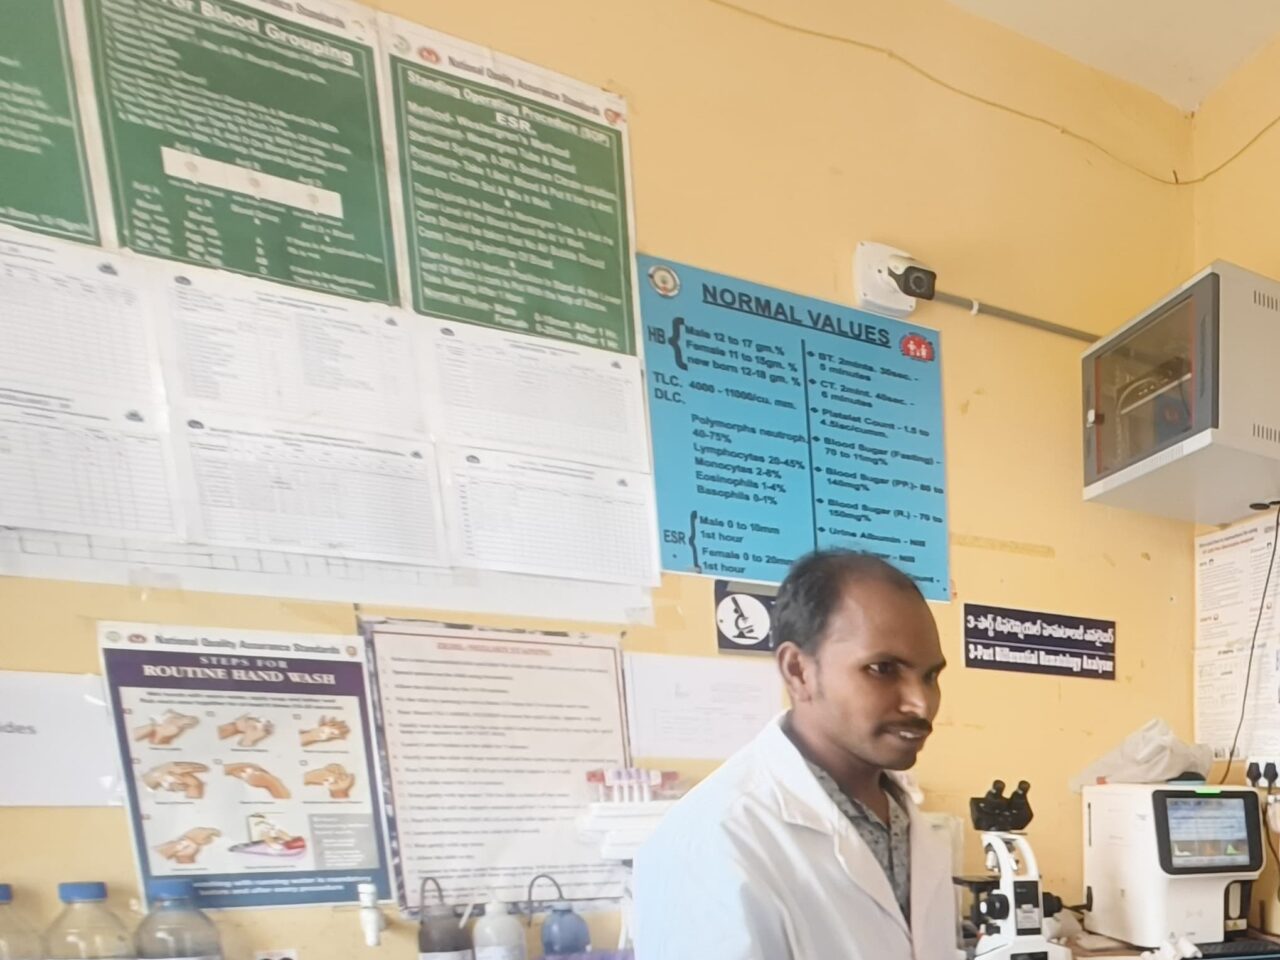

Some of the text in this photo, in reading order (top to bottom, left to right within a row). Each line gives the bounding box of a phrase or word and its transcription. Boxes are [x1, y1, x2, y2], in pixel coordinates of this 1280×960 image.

[200, 0, 259, 33] Blood
[264, 20, 353, 67] Grouping
[407, 69, 460, 99] Standing
[462, 86, 519, 117] Operating
[702, 282, 890, 345] NORMAL VALUES
[647, 325, 666, 345] HB
[685, 324, 711, 339] Male
[713, 331, 726, 343] 12
[728, 335, 739, 346] to
[741, 337, 752, 349] 17
[686, 339, 725, 356] Female
[727, 349, 739, 359] 11
[741, 352, 752, 362] to
[788, 362, 797, 372] %
[653, 371, 682, 388] TLC.
[687, 355, 710, 367] new
[712, 359, 738, 373] born
[768, 372, 787, 386] gm.
[791, 377, 800, 387] %
[828, 365, 871, 382] minutes
[819, 380, 836, 390] CT.
[654, 387, 685, 404] DLC.
[830, 392, 872, 408] minutes
[863, 416, 895, 430] Count
[919, 428, 929, 437] to
[693, 442, 765, 464] Lymphocytes
[823, 436, 934, 467] Blood Sugar (Fasting)
[840, 450, 851, 459] to
[694, 457, 753, 475] Monocytes
[695, 470, 758, 490] Eosinophils
[825, 466, 857, 480] Blood
[859, 472, 889, 487] Sugar
[933, 485, 943, 494] to
[696, 484, 750, 502] Basophils
[827, 498, 859, 511] Blood
[861, 503, 890, 517] Sugar
[932, 515, 942, 523] to
[699, 516, 724, 527] Male
[726, 520, 734, 528] 0
[736, 521, 747, 530] to
[663, 529, 686, 545] ESR
[700, 529, 743, 543] 1st hour
[828, 526, 857, 538] Urine
[860, 531, 901, 544] Albumin
[702, 547, 740, 560] Female
[742, 552, 749, 561] 0
[752, 554, 762, 562] to
[702, 560, 745, 574] 1st hour
[154, 634, 340, 654] National Quality Assurance Standards
[968, 643, 993, 660] 3-Part
[199, 656, 288, 668] STEPS FOR
[142, 665, 336, 685] ROUTINE HAND WASH
